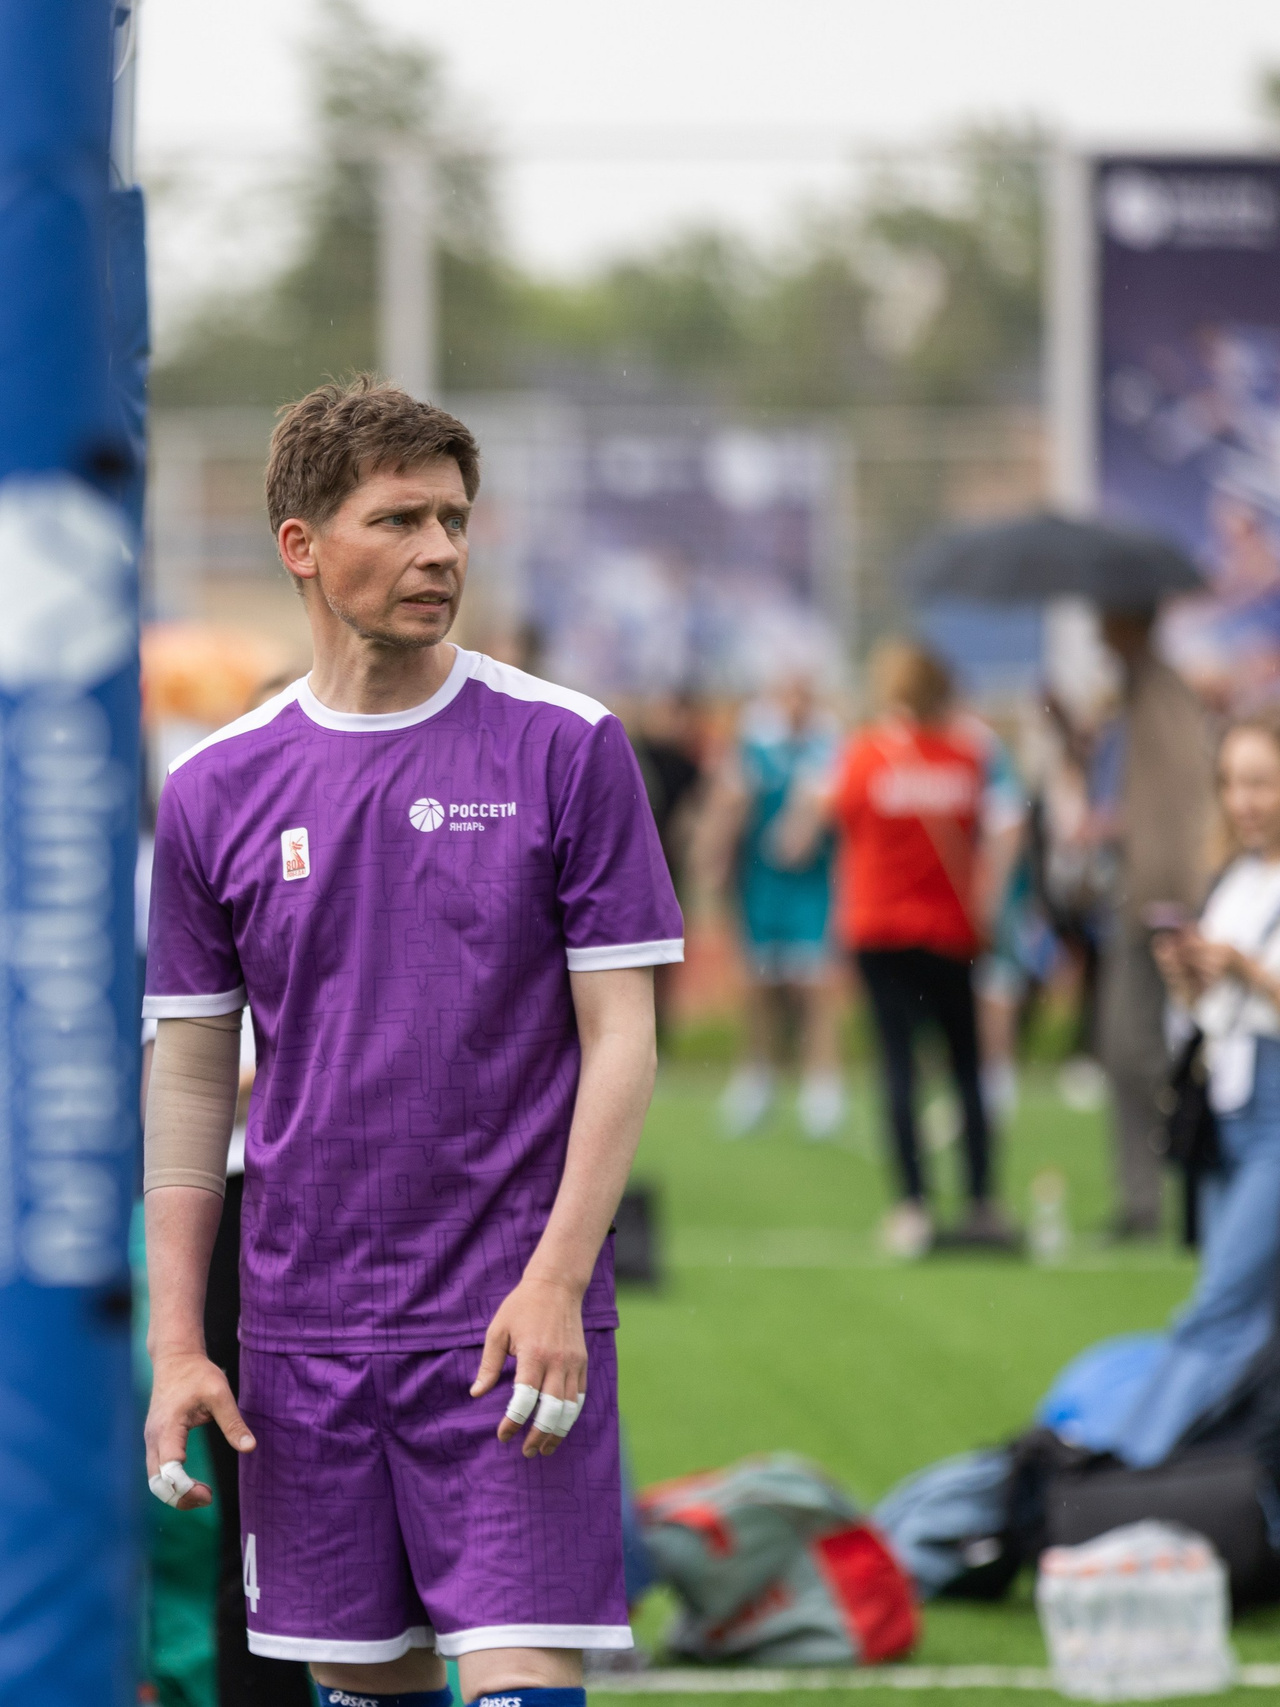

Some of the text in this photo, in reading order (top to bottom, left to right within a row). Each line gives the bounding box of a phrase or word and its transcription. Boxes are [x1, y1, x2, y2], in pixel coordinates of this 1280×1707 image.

[449, 802, 517, 818] РОССЕТИ
[449, 822, 485, 832] ЯНТАРЬ
[243, 1532, 261, 1614] 4
